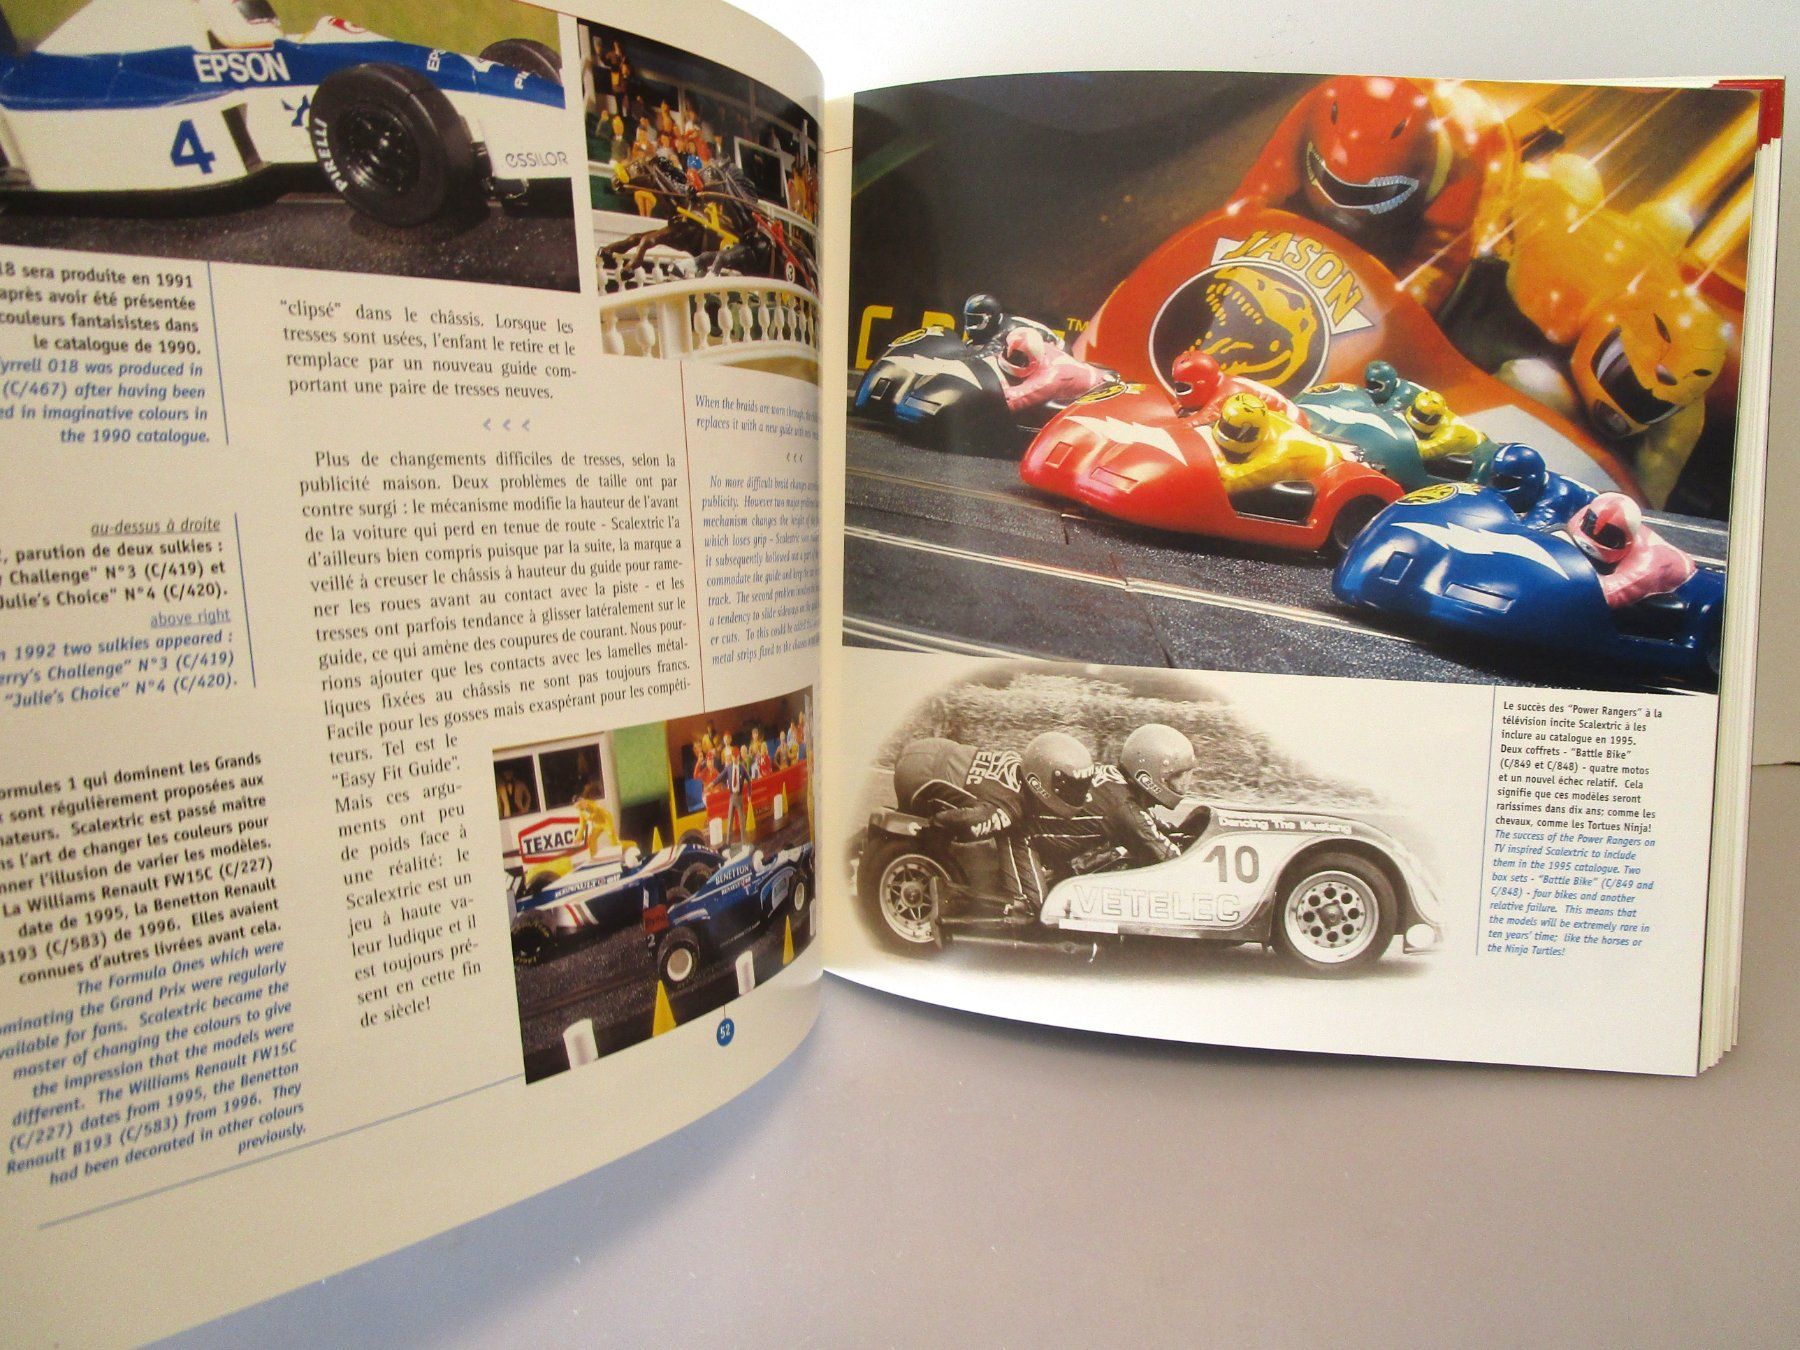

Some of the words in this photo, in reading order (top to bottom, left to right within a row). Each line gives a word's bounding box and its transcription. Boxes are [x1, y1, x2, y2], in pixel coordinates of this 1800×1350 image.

[193, 52, 290, 83] EPSON
[170, 119, 216, 174] 4
[314, 118, 348, 192] PIRELLI
[22, 266, 54, 279] sera
[61, 268, 126, 284] produite
[132, 274, 150, 285] en
[157, 273, 192, 288] 1991
[1220, 230, 1363, 326] JASON
[49, 290, 87, 304] avoir
[93, 291, 117, 306] été
[124, 294, 195, 310] présentée
[71, 312, 160, 331] fantaisistes
[165, 318, 198, 332] dans
[356, 304, 392, 321] dans
[405, 307, 417, 322] le
[496, 314, 546, 334] Lorsque
[557, 318, 573, 334] les
[1067, 317, 1088, 332] TM
[34, 334, 48, 349] le
[54, 337, 128, 355] catalogue
[135, 338, 152, 353] de
[283, 328, 336, 342] tresses
[343, 331, 375, 344] sont
[383, 331, 426, 348] usées,
[434, 332, 486, 350] l'enfant
[493, 336, 504, 350] le
[510, 339, 543, 353] retire
[549, 343, 559, 354] et
[565, 341, 575, 355] le
[287, 352, 358, 371] remplace
[369, 358, 394, 372] par
[404, 359, 422, 370] un
[433, 360, 492, 373] nouveau
[502, 361, 536, 377] guide
[545, 366, 576, 377] com-
[75, 382, 112, 400] after
[118, 383, 167, 401] having
[172, 384, 205, 398] been
[60, 428, 85, 442] the
[94, 429, 131, 442] 1990
[316, 451, 349, 466] Plus
[362, 451, 378, 466] de
[390, 451, 486, 470] changements
[496, 452, 552, 465] difficiles
[562, 452, 574, 465] de
[584, 454, 624, 467] tresses,
[632, 453, 659, 466] selon
[667, 454, 675, 466] la
[136, 678, 165, 695] N°4
[328, 721, 372, 740] Facile
[380, 718, 413, 738] pour
[420, 714, 438, 728] les
[444, 709, 488, 727] gosses
[494, 701, 524, 718] mais
[530, 693, 595, 712] exaspérant
[601, 690, 626, 706] pour
[630, 686, 644, 698] les
[648, 680, 690, 696] compéti-
[1504, 701, 1514, 710] Le
[1518, 704, 1545, 712] succès
[1549, 704, 1564, 712] des
[1568, 705, 1598, 714] "Power
[1602, 706, 1642, 718] Rangers"
[1654, 709, 1662, 718] la
[1502, 716, 1546, 726] télévision
[1550, 720, 1576, 728] incite
[1579, 720, 1622, 730] Scalextric
[1634, 722, 1646, 731] les
[1502, 730, 1532, 740] inclure
[1550, 733, 1592, 744] catalogue
[1611, 736, 1636, 745] 1995.
[332, 772, 375, 788] "Easy
[383, 765, 401, 781] Fit
[409, 756, 460, 776] Guide".
[1526, 776, 1555, 784] nouvel
[1558, 776, 1583, 786] échec
[1587, 778, 1617, 787] relatif.
[1625, 780, 1643, 788] Cela
[1498, 788, 1531, 798] signifie
[1535, 791, 1551, 800] que
[1572, 792, 1609, 801] modèles
[1497, 802, 1542, 812] rarissimes
[1545, 804, 1565, 813] dans
[1569, 805, 1582, 814] dix
[1586, 808, 1604, 816] ans;
[1643, 809, 1655, 818] les
[1271, 818, 1296, 830] The
[1496, 816, 1533, 827] chevaux,
[1537, 820, 1568, 828] comme
[1572, 820, 1584, 828] les
[1588, 820, 1620, 830] Tortues
[1624, 823, 1651, 834] Ninja!
[1496, 830, 1510, 838] The
[1548, 832, 1558, 843] of
[1560, 833, 1574, 842] the
[1577, 834, 1604, 844] Power
[1606, 836, 1641, 847] Rangers
[1202, 844, 1260, 884] 10
[3, 904, 21, 917] La
[27, 892, 95, 912] Williams
[102, 878, 158, 899] Renault
[164, 867, 212, 888] FW15C
[1073, 884, 1240, 922] VETELEC
[648, 934, 656, 947] 2
[1488, 943, 1502, 952] the
[1505, 944, 1528, 956] Ninja
[1532, 946, 1565, 956] Turtles!
[361, 1012, 377, 1028] de
[384, 996, 430, 1021] siècle!
[13, 1058, 66, 1080] master
[73, 1048, 88, 1067] of
[94, 1035, 160, 1060] changing
[166, 1026, 188, 1042] the
[194, 1015, 241, 1035] colours
[247, 1010, 260, 1022] to
[265, 1002, 291, 1021] give
[720, 1024, 730, 1039] 52
